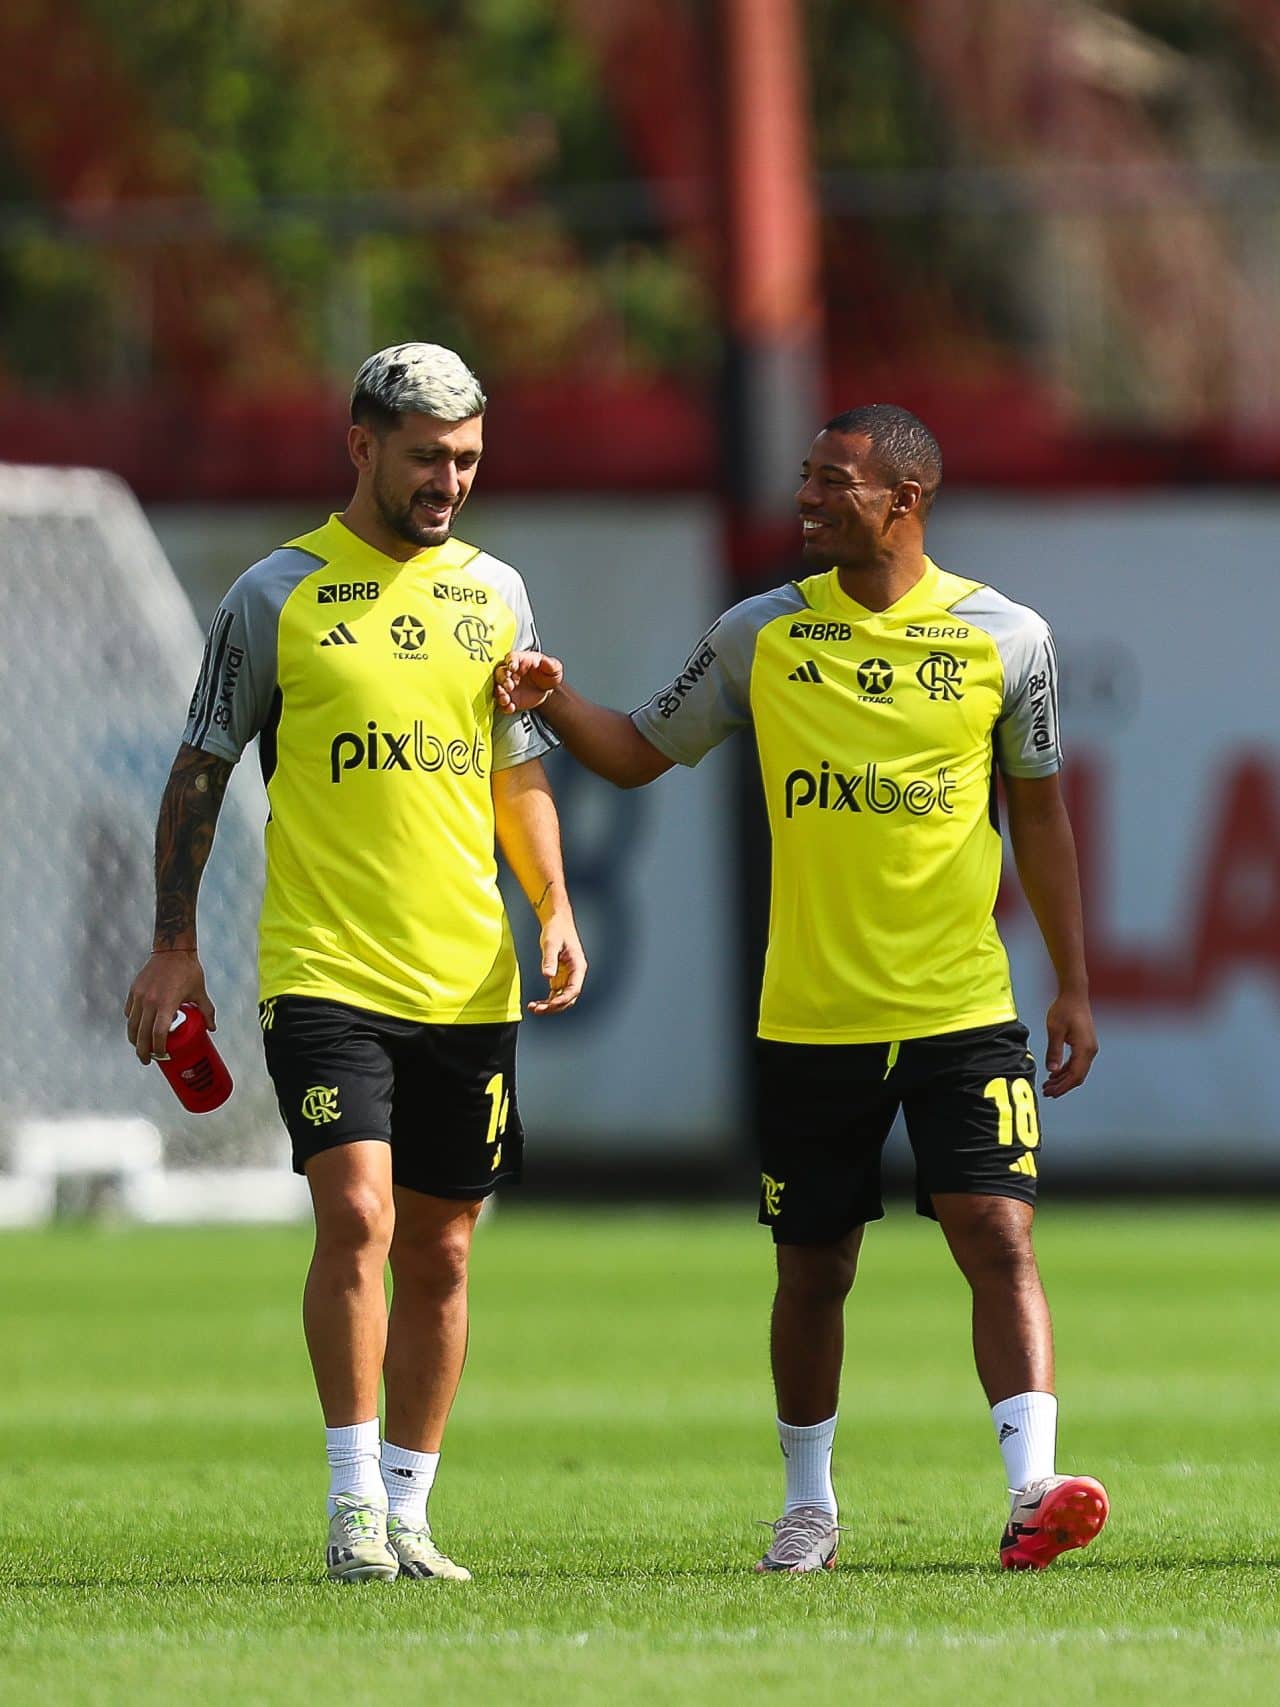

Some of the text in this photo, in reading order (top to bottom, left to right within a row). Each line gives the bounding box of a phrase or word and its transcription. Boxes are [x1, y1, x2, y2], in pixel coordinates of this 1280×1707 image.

[339, 581, 380, 602] BRB
[451, 585, 488, 605] BRB
[811, 622, 853, 641] BRB
[927, 626, 969, 639] BRB
[220, 643, 246, 702] kwai
[675, 641, 718, 697] kwai
[857, 695, 894, 705] TEXACO
[1030, 693, 1055, 753] kwai
[330, 719, 486, 784] pixbet
[785, 760, 958, 819] pixbet
[983, 1076, 1040, 1149] 18
